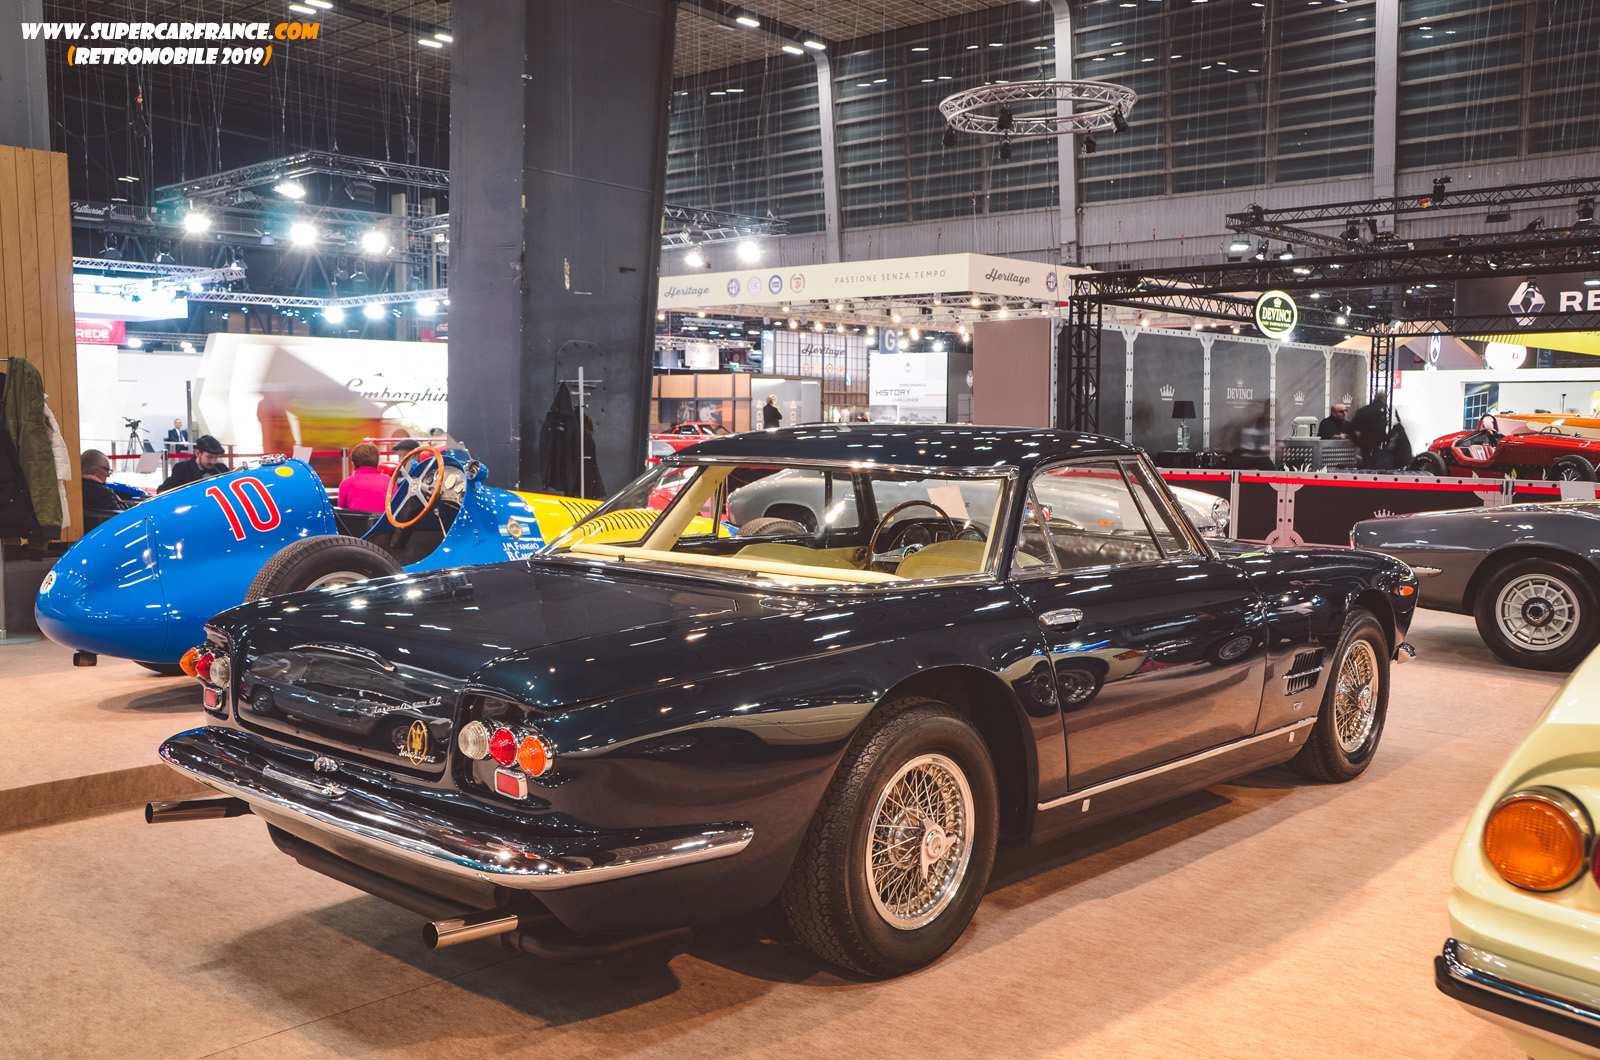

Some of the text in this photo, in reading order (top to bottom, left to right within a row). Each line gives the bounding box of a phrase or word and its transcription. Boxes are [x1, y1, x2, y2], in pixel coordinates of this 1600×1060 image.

[834, 269, 946, 284] PASSIONE SENZA TEMPO
[984, 267, 1031, 286] Heritage
[663, 286, 710, 299] Heritage
[1560, 289, 1600, 313] RE
[1261, 306, 1292, 323] DEVINCI
[885, 329, 896, 351] G
[801, 343, 846, 358] Heritage
[875, 389, 911, 397] HISTORY
[1226, 387, 1253, 400] DEVINCI
[205, 476, 281, 542] 10
